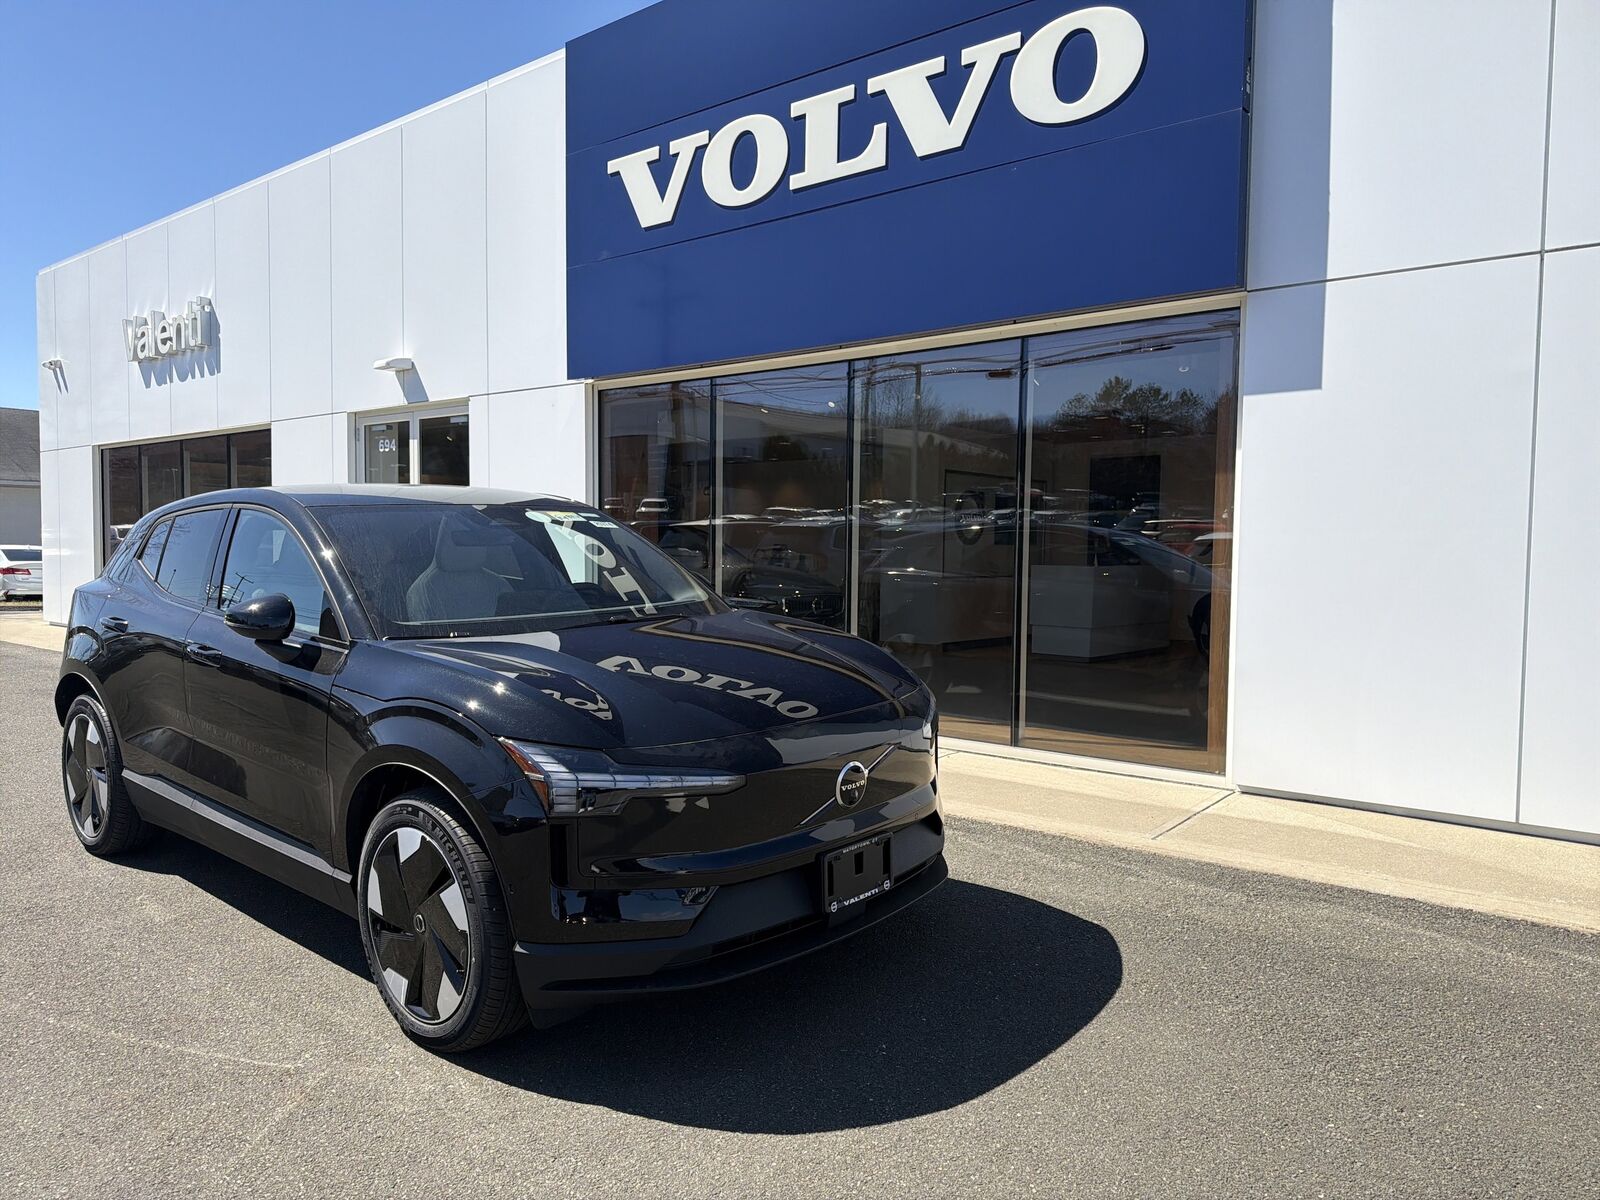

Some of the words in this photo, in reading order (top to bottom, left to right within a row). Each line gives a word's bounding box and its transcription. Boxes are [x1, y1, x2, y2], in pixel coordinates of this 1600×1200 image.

[607, 6, 1146, 229] VOLVO
[122, 296, 212, 362] Valenti
[378, 439, 397, 452] 694
[841, 780, 865, 791] VOLVO
[433, 826, 474, 899] MICHELIN
[843, 888, 879, 906] VALENTI
